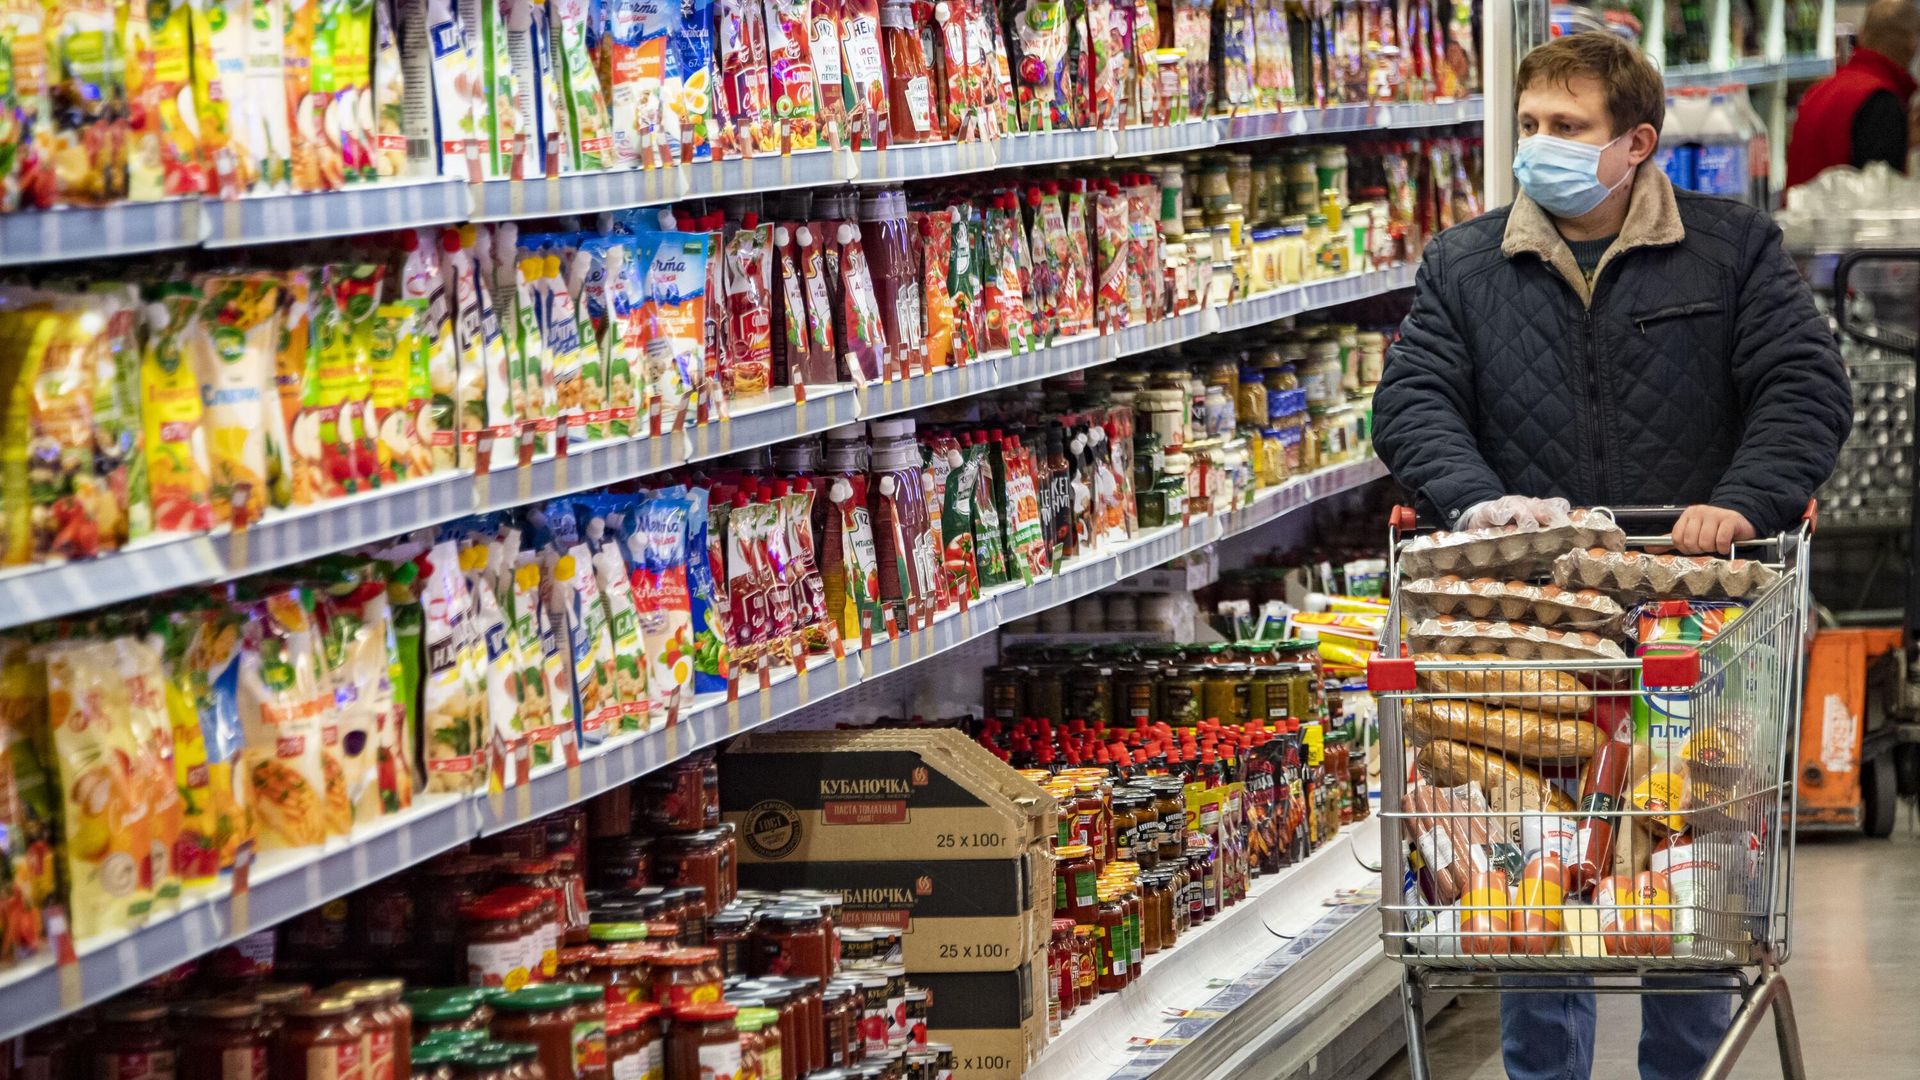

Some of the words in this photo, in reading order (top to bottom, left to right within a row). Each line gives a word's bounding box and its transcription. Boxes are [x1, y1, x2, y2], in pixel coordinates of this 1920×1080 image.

[820, 779, 910, 794] КУБАНОЧКА
[937, 834, 955, 847] 25
[972, 833, 999, 847] 100
[829, 888, 913, 903] БАНОЧКА
[841, 912, 860, 922] АСТА
[940, 944, 958, 958] 25
[976, 944, 1002, 957] 100
[977, 1056, 1003, 1069] 100
